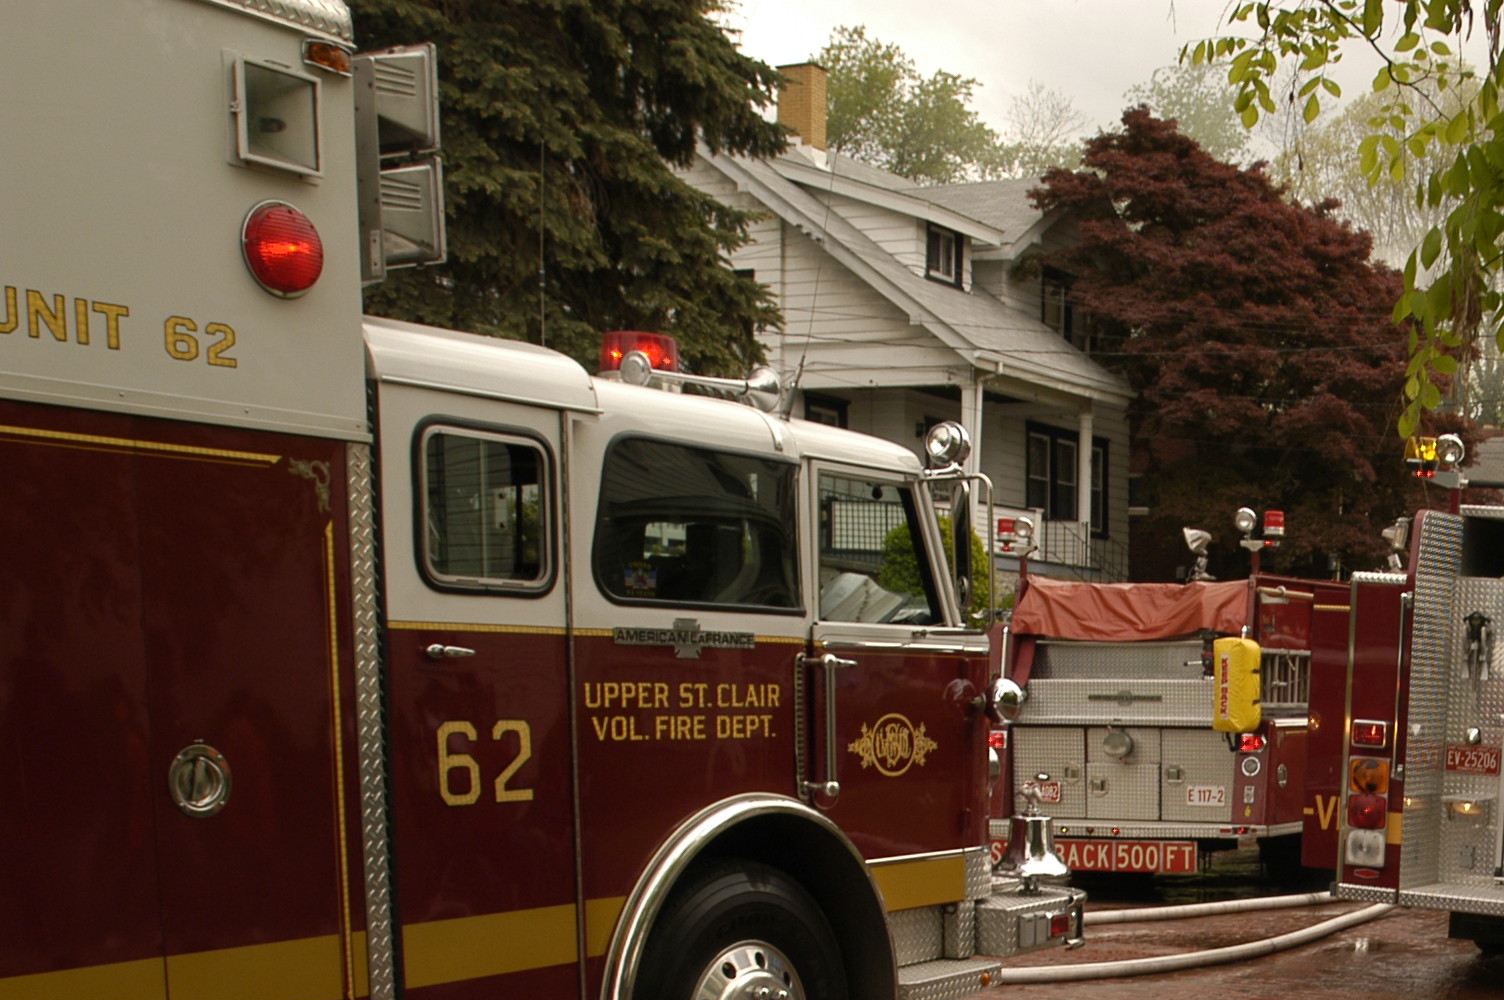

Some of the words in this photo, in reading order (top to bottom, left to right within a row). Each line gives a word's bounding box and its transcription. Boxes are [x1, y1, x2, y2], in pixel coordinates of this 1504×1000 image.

[164, 315, 238, 368] 62
[616, 630, 687, 643] AMERICAN
[584, 682, 669, 708] UPPER
[679, 683, 712, 708] ST.
[717, 683, 780, 708] CLAIR
[592, 716, 650, 741] VOL.
[655, 715, 707, 740] FIRE
[717, 714, 777, 738] DEPT.
[437, 720, 534, 806] 62
[1447, 750, 1497, 769] EV-25206
[1188, 789, 1195, 802] E
[1198, 789, 1224, 803] 117-2
[1117, 845, 1157, 870] 500
[1166, 846, 1193, 870] FT
